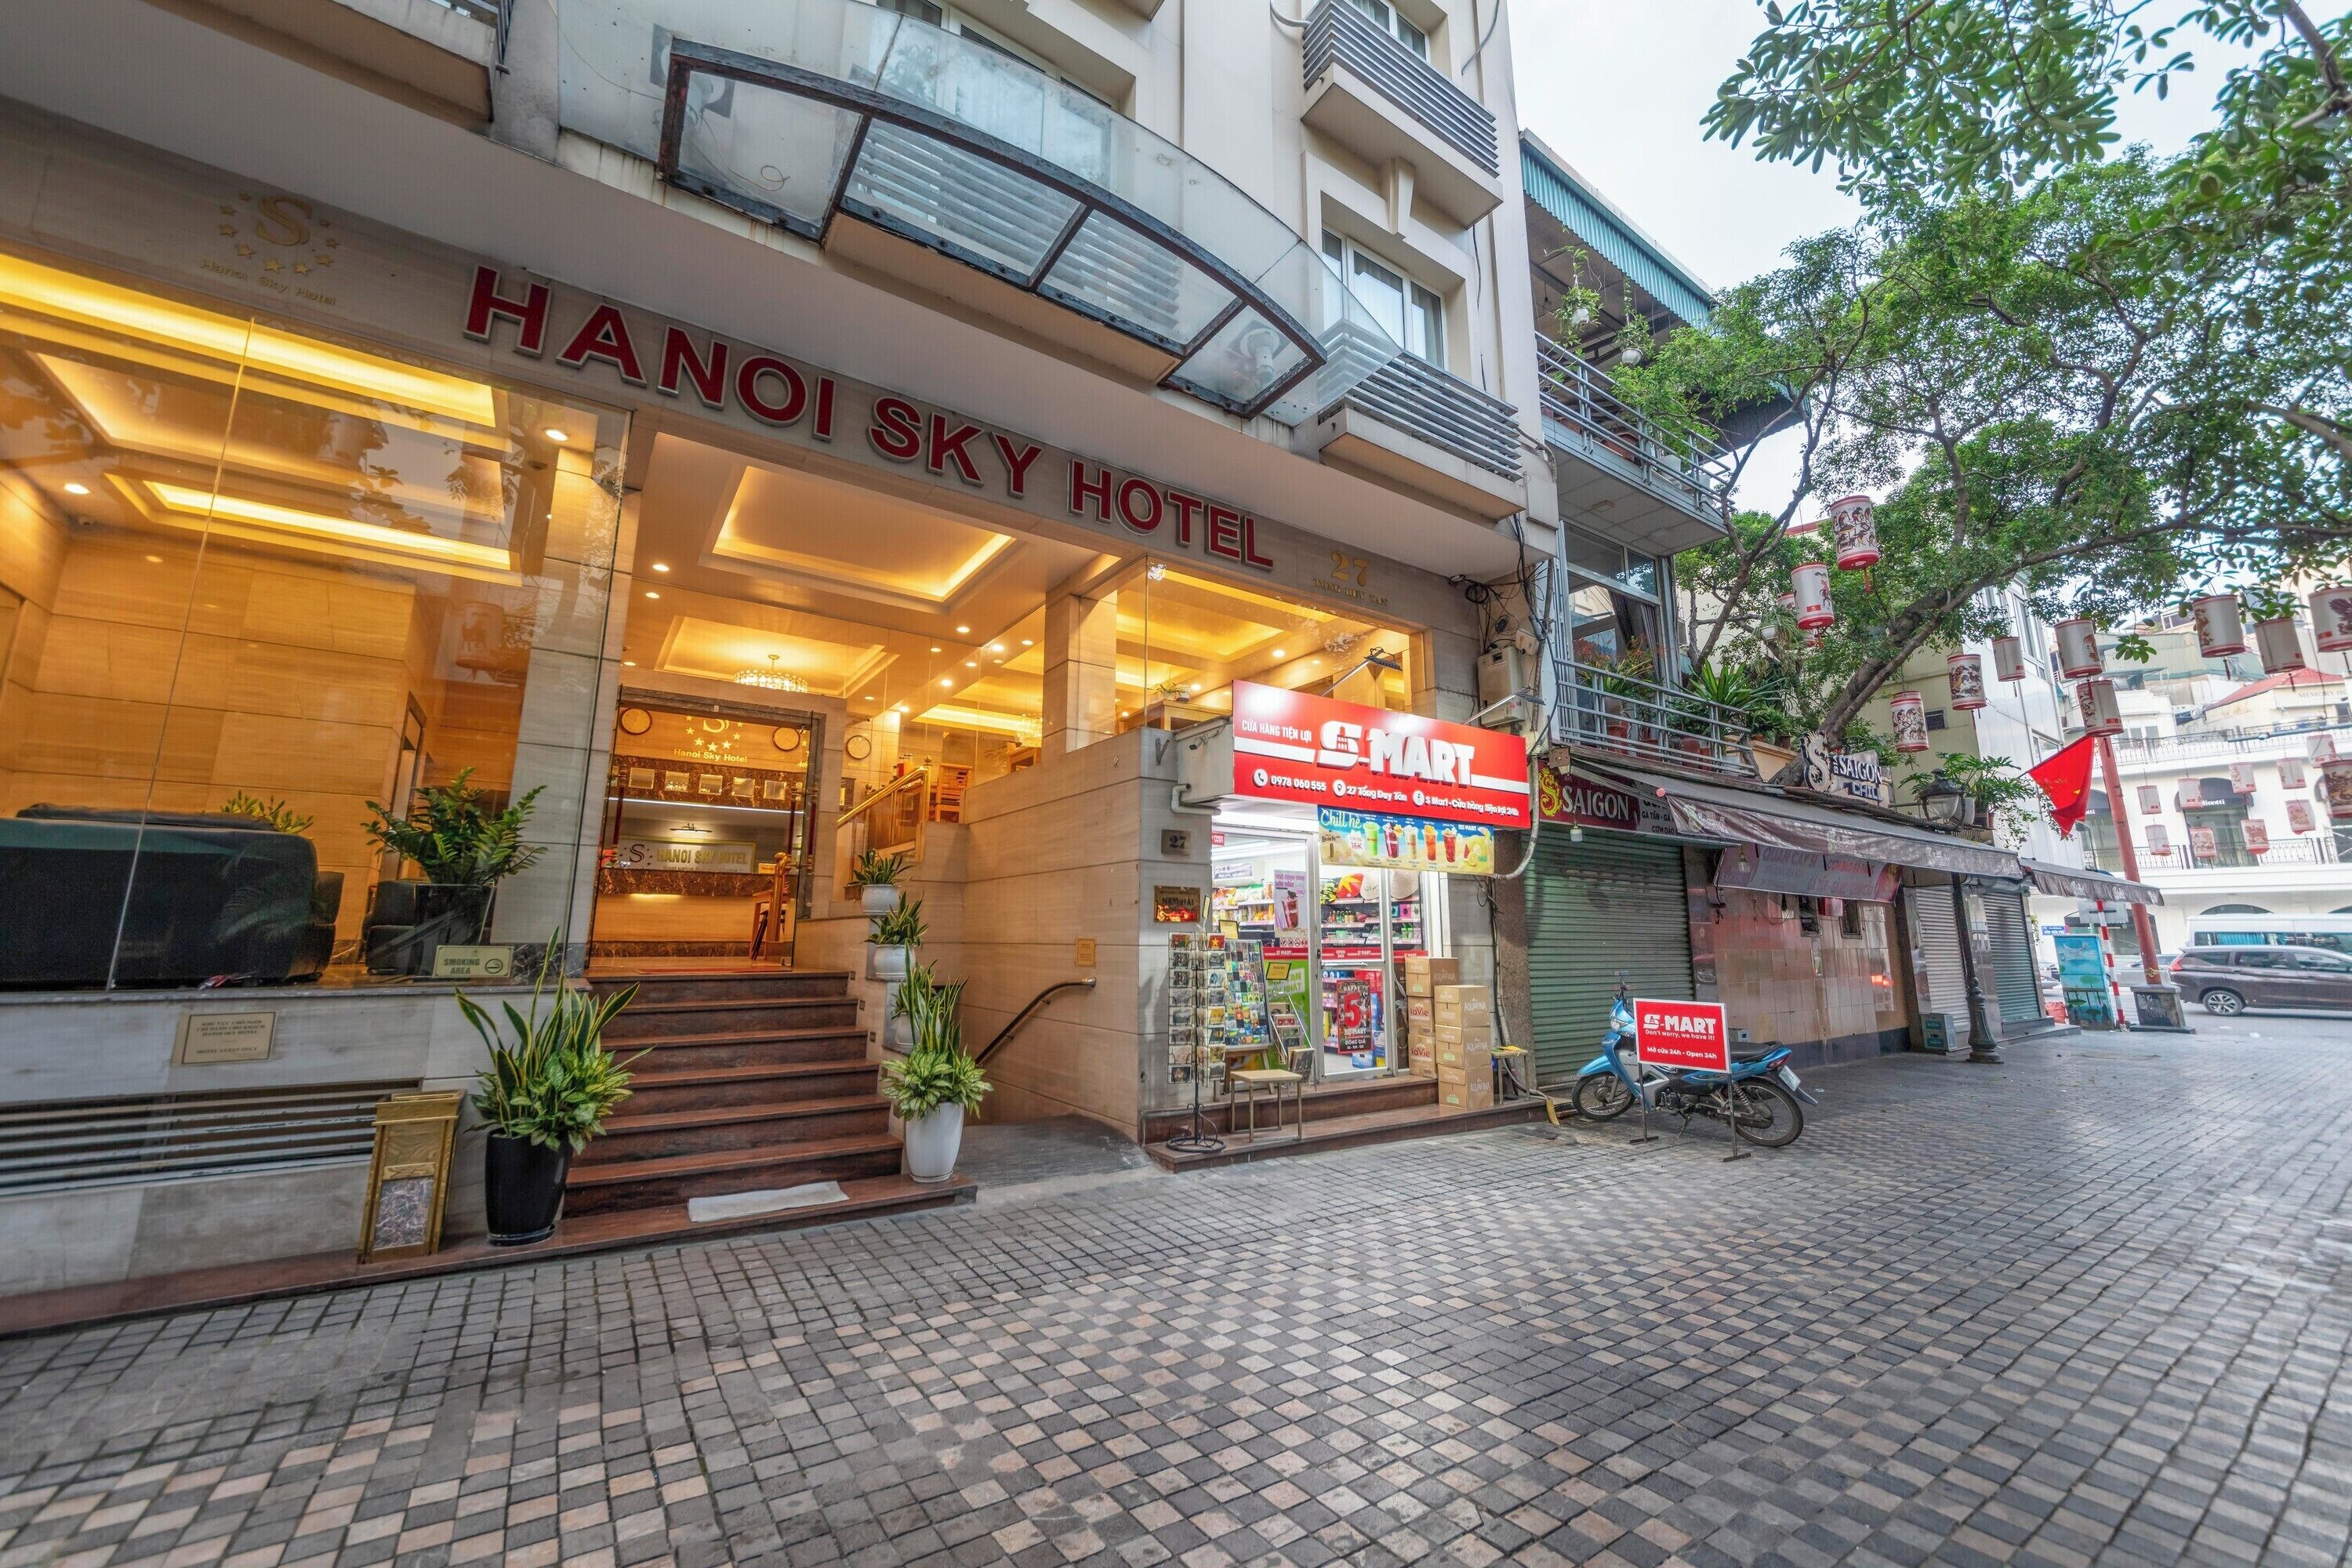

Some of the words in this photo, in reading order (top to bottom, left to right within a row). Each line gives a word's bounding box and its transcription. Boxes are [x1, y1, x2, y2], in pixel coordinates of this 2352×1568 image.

[201, 260, 248, 281] Hanoi
[260, 276, 288, 293] Sky
[297, 288, 336, 305] Hotel
[463, 265, 837, 443] HANOI
[868, 396, 1043, 499] SKY
[1067, 458, 1274, 572] HOTEL
[1331, 551, 1369, 587] 27
[1242, 717, 1258, 732] CỬA
[1260, 722, 1280, 736] HÀNG
[1282, 725, 1299, 742] TIỆN
[673, 749, 701, 758] Hanoi
[703, 752, 720, 762] Sky
[1839, 755, 1882, 785] SAIGON
[1270, 775, 1292, 788] 0978
[1294, 779, 1309, 790] 060
[1311, 782, 1327, 792] 555
[1347, 785, 1356, 795] 27
[1377, 790, 1392, 802] Duy
[1851, 782, 1882, 800] CHILL
[1563, 785, 1629, 821] SAIGON
[1320, 808, 1346, 826] Chill
[1348, 812, 1363, 828] hè
[1169, 835, 1186, 848] 27
[657, 848, 691, 863] HANOI
[1344, 992, 1362, 1029] 5
[1465, 1002, 1488, 1012] AQUAFINA
[1643, 1014, 1716, 1035] S-MART
